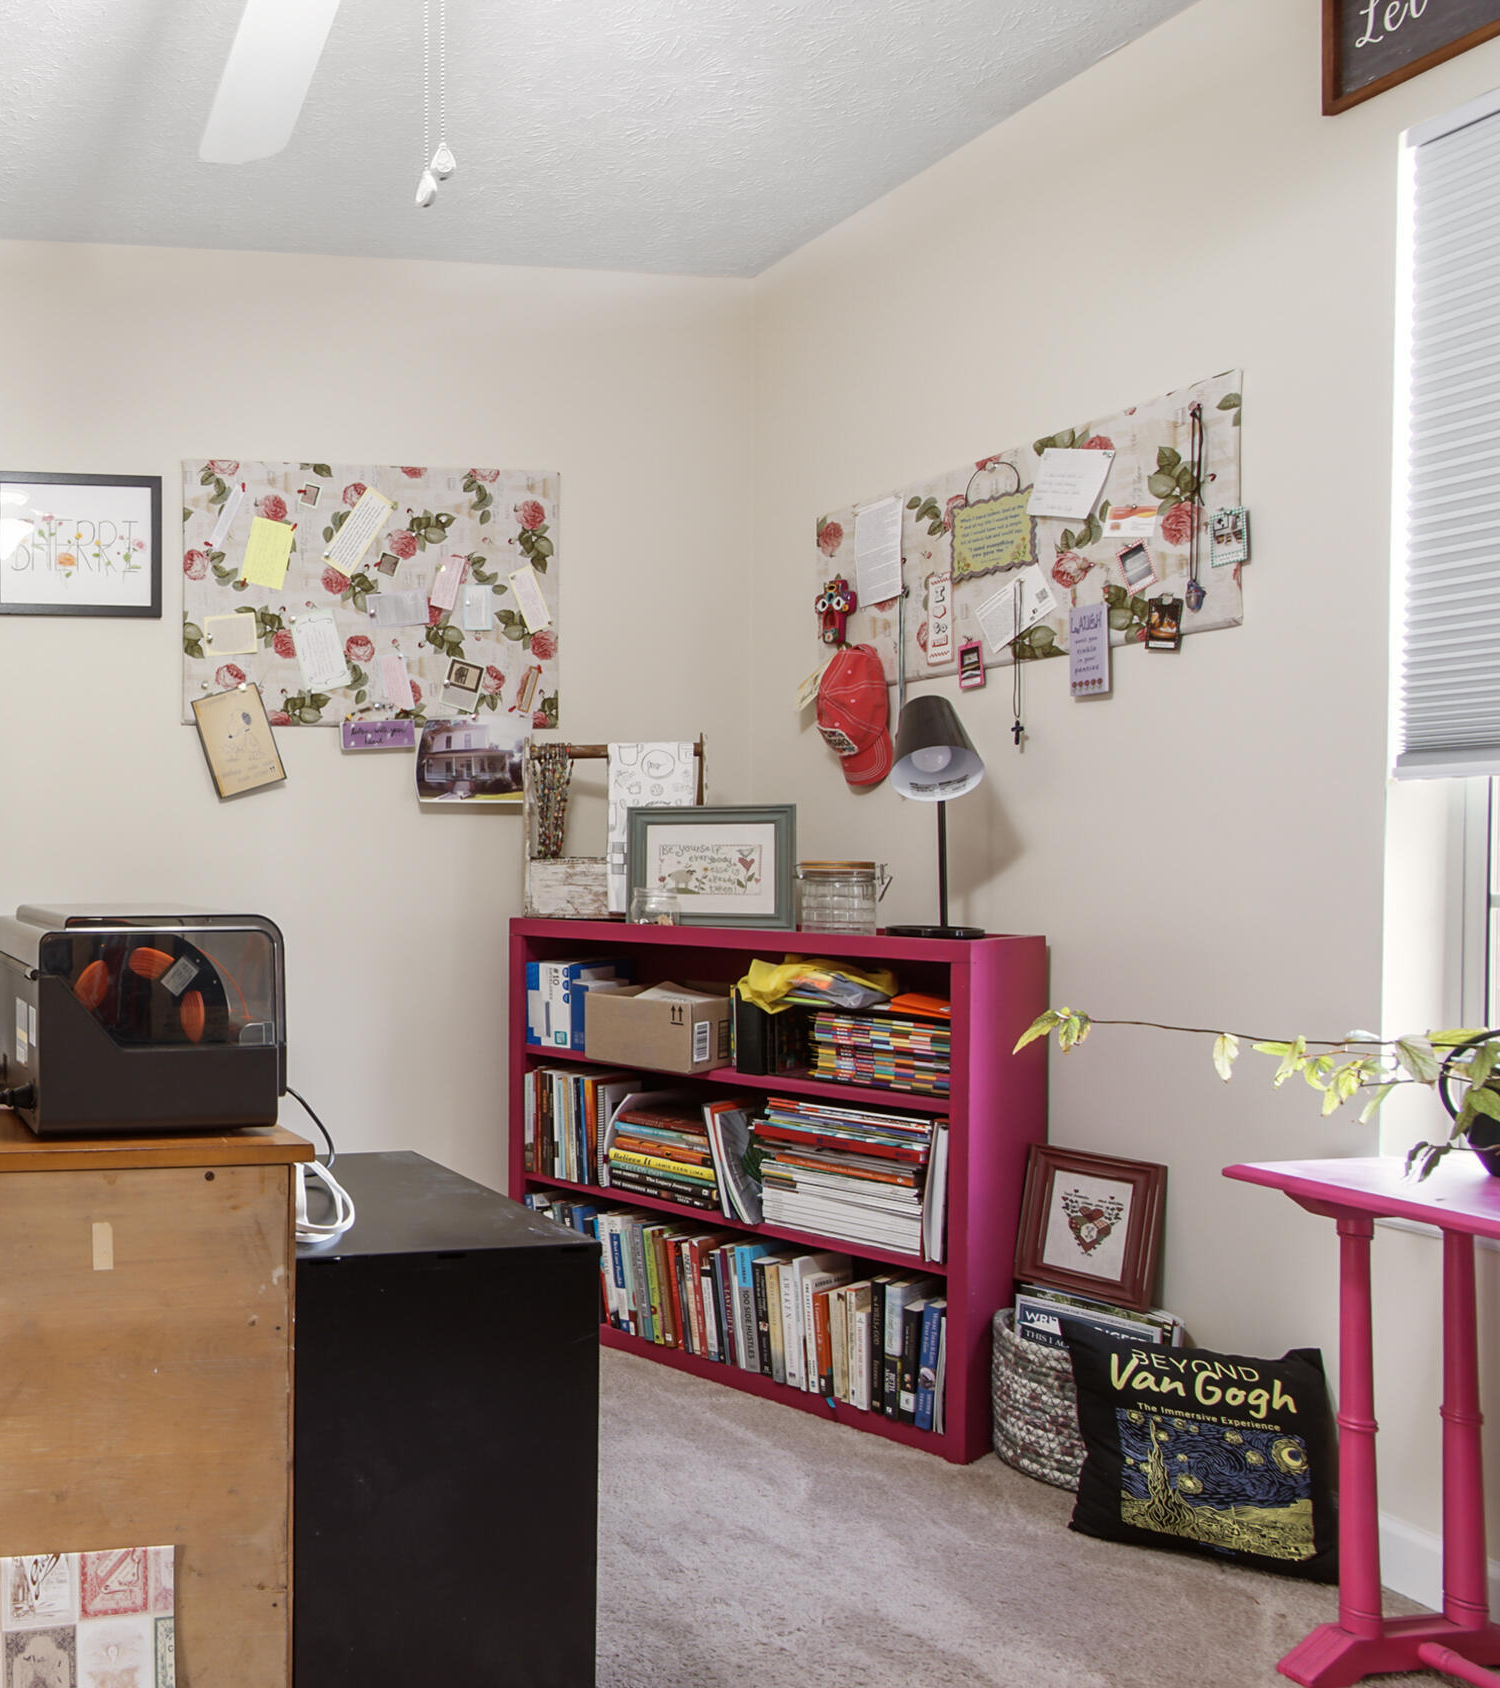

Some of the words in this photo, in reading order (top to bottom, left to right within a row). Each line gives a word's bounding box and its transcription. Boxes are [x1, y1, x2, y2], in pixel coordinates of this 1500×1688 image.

[613, 1152, 642, 1164] Believe
[742, 1290, 750, 1305] 100
[783, 1276, 792, 1319] AWAKEN
[744, 1307, 752, 1324] SIDE
[746, 1325, 755, 1360] HUSTLES
[1025, 1330, 1047, 1341] THIS
[1132, 1349, 1260, 1382] BEYOND
[1110, 1353, 1186, 1397] Van
[1195, 1370, 1297, 1420] Gogh
[1137, 1402, 1158, 1413] The
[1160, 1404, 1218, 1424] Immersive
[1220, 1416, 1282, 1432] Experience
